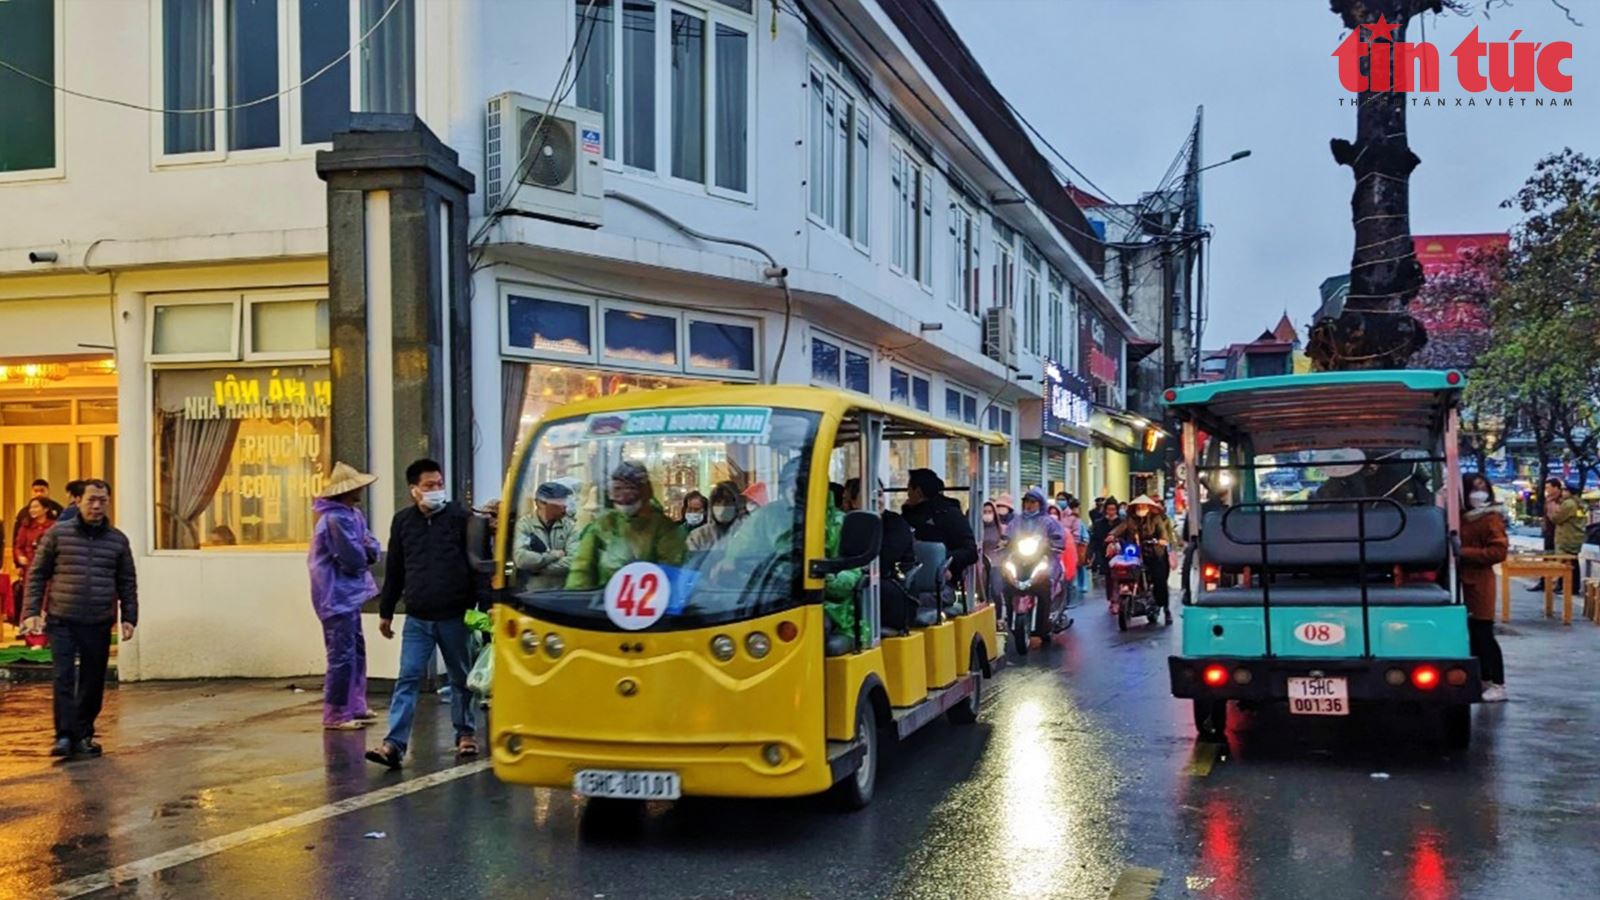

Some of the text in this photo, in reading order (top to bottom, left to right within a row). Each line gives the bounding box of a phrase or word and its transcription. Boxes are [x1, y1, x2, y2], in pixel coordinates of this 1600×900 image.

[615, 573, 659, 617] 42
[1304, 624, 1330, 642] 08
[1295, 699, 1342, 712] 001.36
